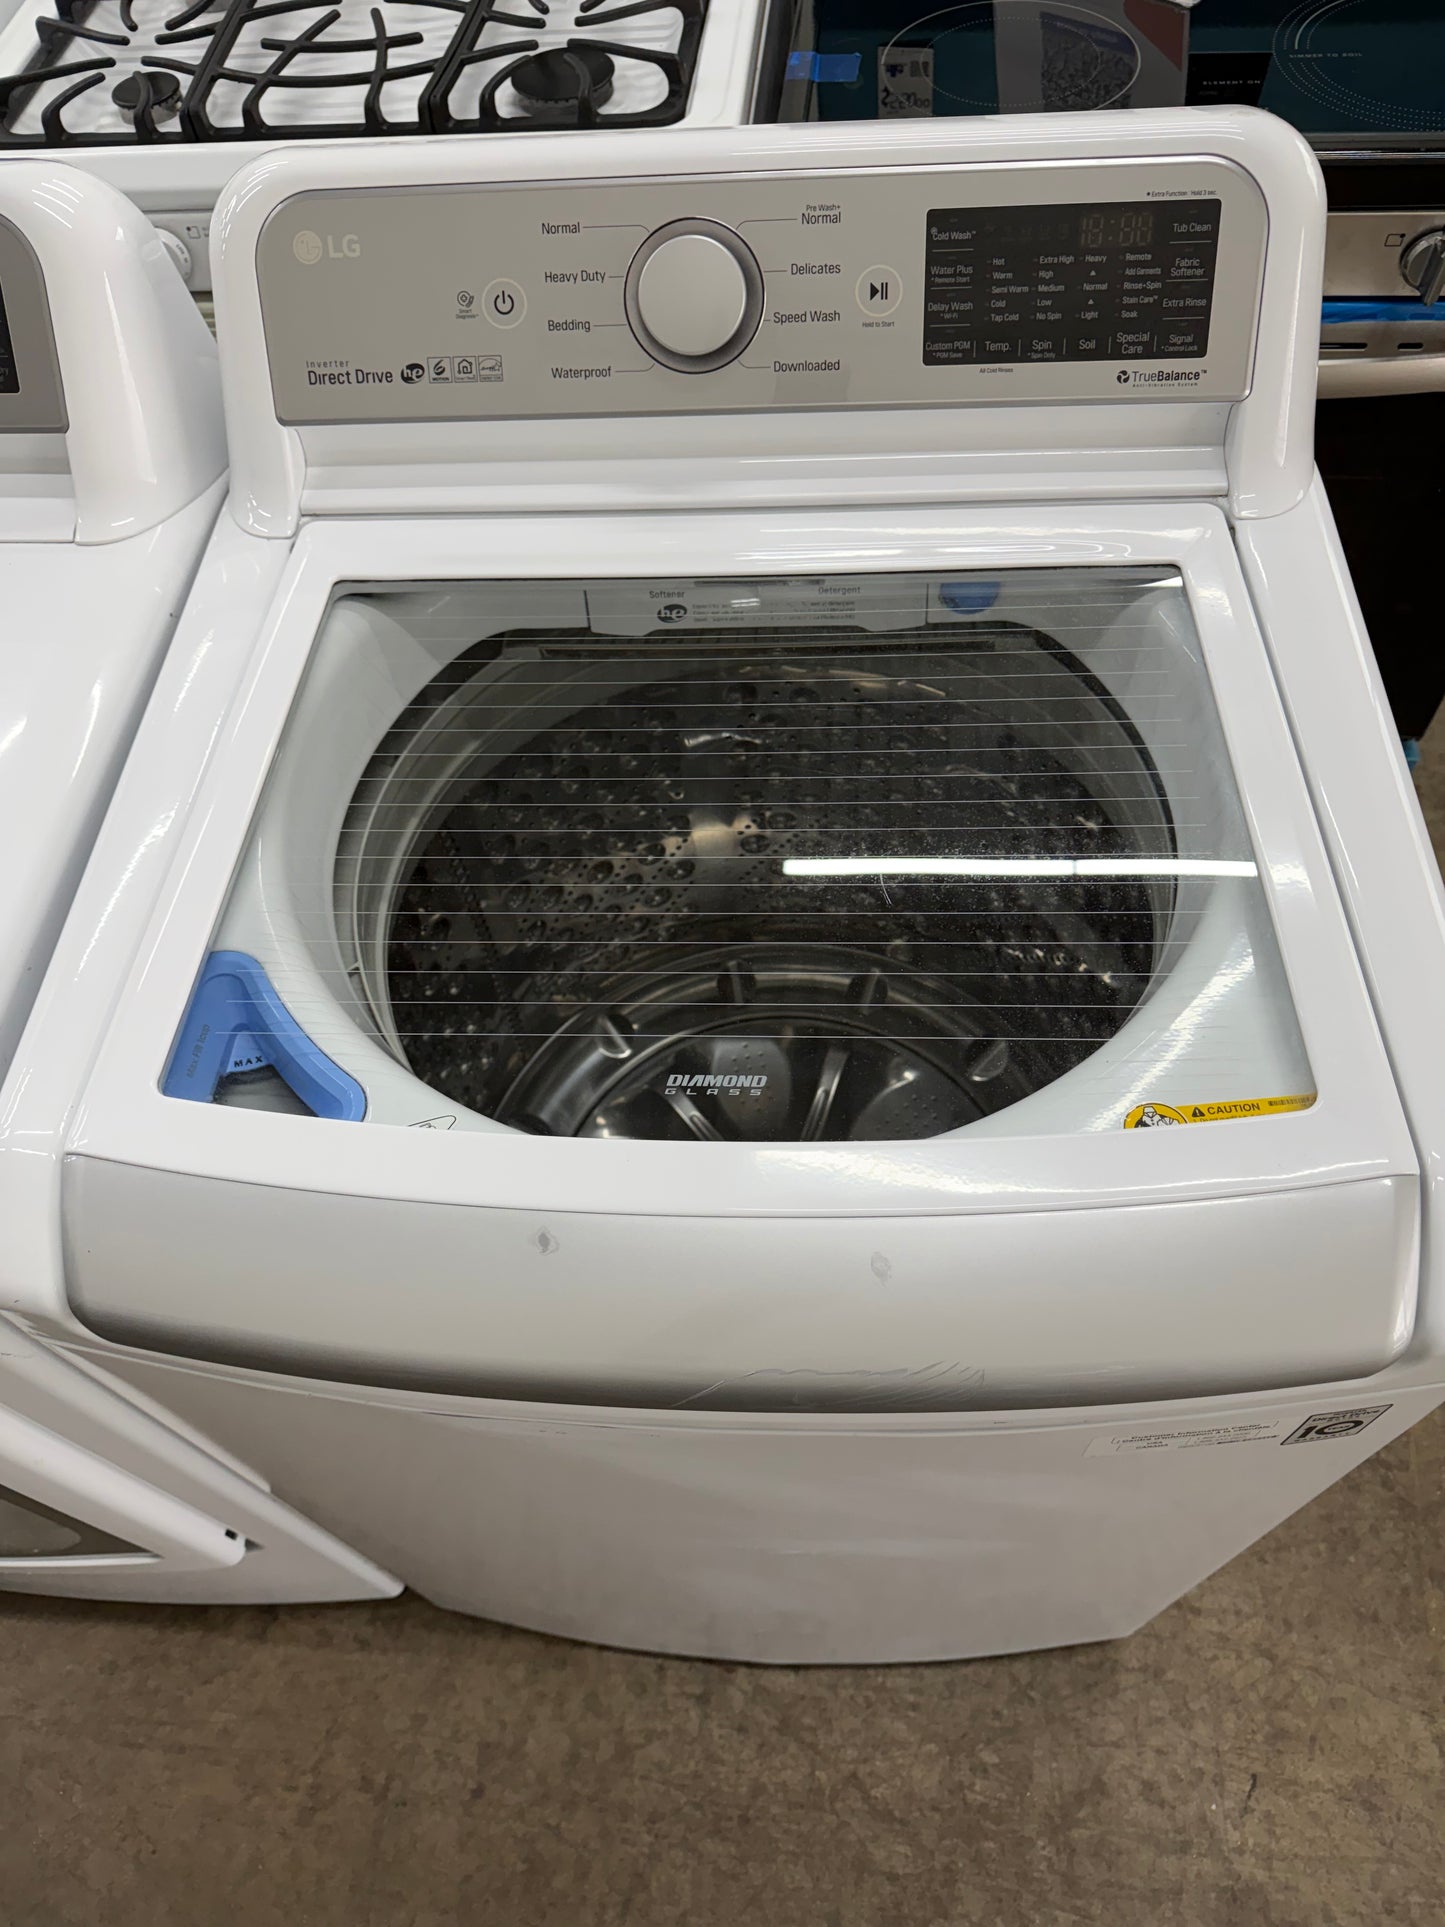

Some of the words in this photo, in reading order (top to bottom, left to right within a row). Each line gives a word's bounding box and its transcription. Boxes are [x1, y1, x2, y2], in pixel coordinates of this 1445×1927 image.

[806, 204, 817, 212] Pre
[801, 212, 841, 225] Normal
[541, 222, 581, 235] Normal
[1173, 223, 1187, 233] Tub
[1189, 222, 1212, 232] Clean
[932, 231, 949, 241] Cold
[327, 234, 361, 258] LG
[992, 258, 1005, 266] Hot
[1040, 256, 1058, 264] Extra
[1059, 255, 1075, 264] High
[1085, 254, 1107, 264] Heavy
[1125, 253, 1152, 262] Remote
[1175, 257, 1201, 267] Fabric
[791, 263, 841, 276] Delicates
[930, 265, 955, 275] Water
[956, 264, 974, 274] Plus
[1038, 270, 1054, 279] High
[1125, 268, 1136, 276] Add
[1170, 267, 1206, 277] Softener
[544, 271, 578, 284] Heavy
[581, 270, 606, 283] Duty
[992, 271, 1013, 280] Warm
[991, 286, 1008, 294] Semi
[1009, 285, 1029, 294] Warm
[1038, 284, 1065, 293] Medium
[1082, 282, 1108, 291] Normal
[990, 300, 1006, 308] Cold
[1037, 299, 1052, 307] Low
[1122, 296, 1138, 305] Stain
[1162, 298, 1184, 308] Extra
[1184, 297, 1207, 307] Rinse
[928, 302, 950, 313] Delay
[951, 301, 974, 311] Wash
[773, 312, 807, 326] Speed
[810, 310, 841, 322] Wash
[990, 313, 1004, 323] Tap
[1004, 313, 1019, 322] Cold
[1036, 312, 1046, 321] No
[1047, 312, 1062, 321] Spin
[1080, 311, 1098, 320] Light
[1121, 310, 1138, 318] Soak
[547, 320, 591, 333] Bedding
[1116, 332, 1150, 344] Special
[1169, 334, 1194, 344] Signal
[925, 341, 953, 351] Custom
[953, 340, 971, 350] PGM
[985, 340, 1012, 353] Temp.
[1032, 339, 1053, 351] Spin
[1079, 339, 1096, 350] Soil
[1121, 344, 1143, 355] Care
[306, 359, 350, 369] Inverter
[773, 359, 840, 373] Downloaded
[307, 369, 352, 386] Direct
[355, 368, 394, 385] Drive
[551, 366, 612, 380] Waterproof
[648, 590, 685, 599] Softener
[818, 586, 861, 596] Detergent
[233, 1055, 263, 1068] MAX
[666, 1074, 768, 1088] DIAMOND
[664, 1088, 762, 1096] GLASS
[1207, 1103, 1260, 1115] CAUTION
[1297, 1420, 1364, 1439] 10
